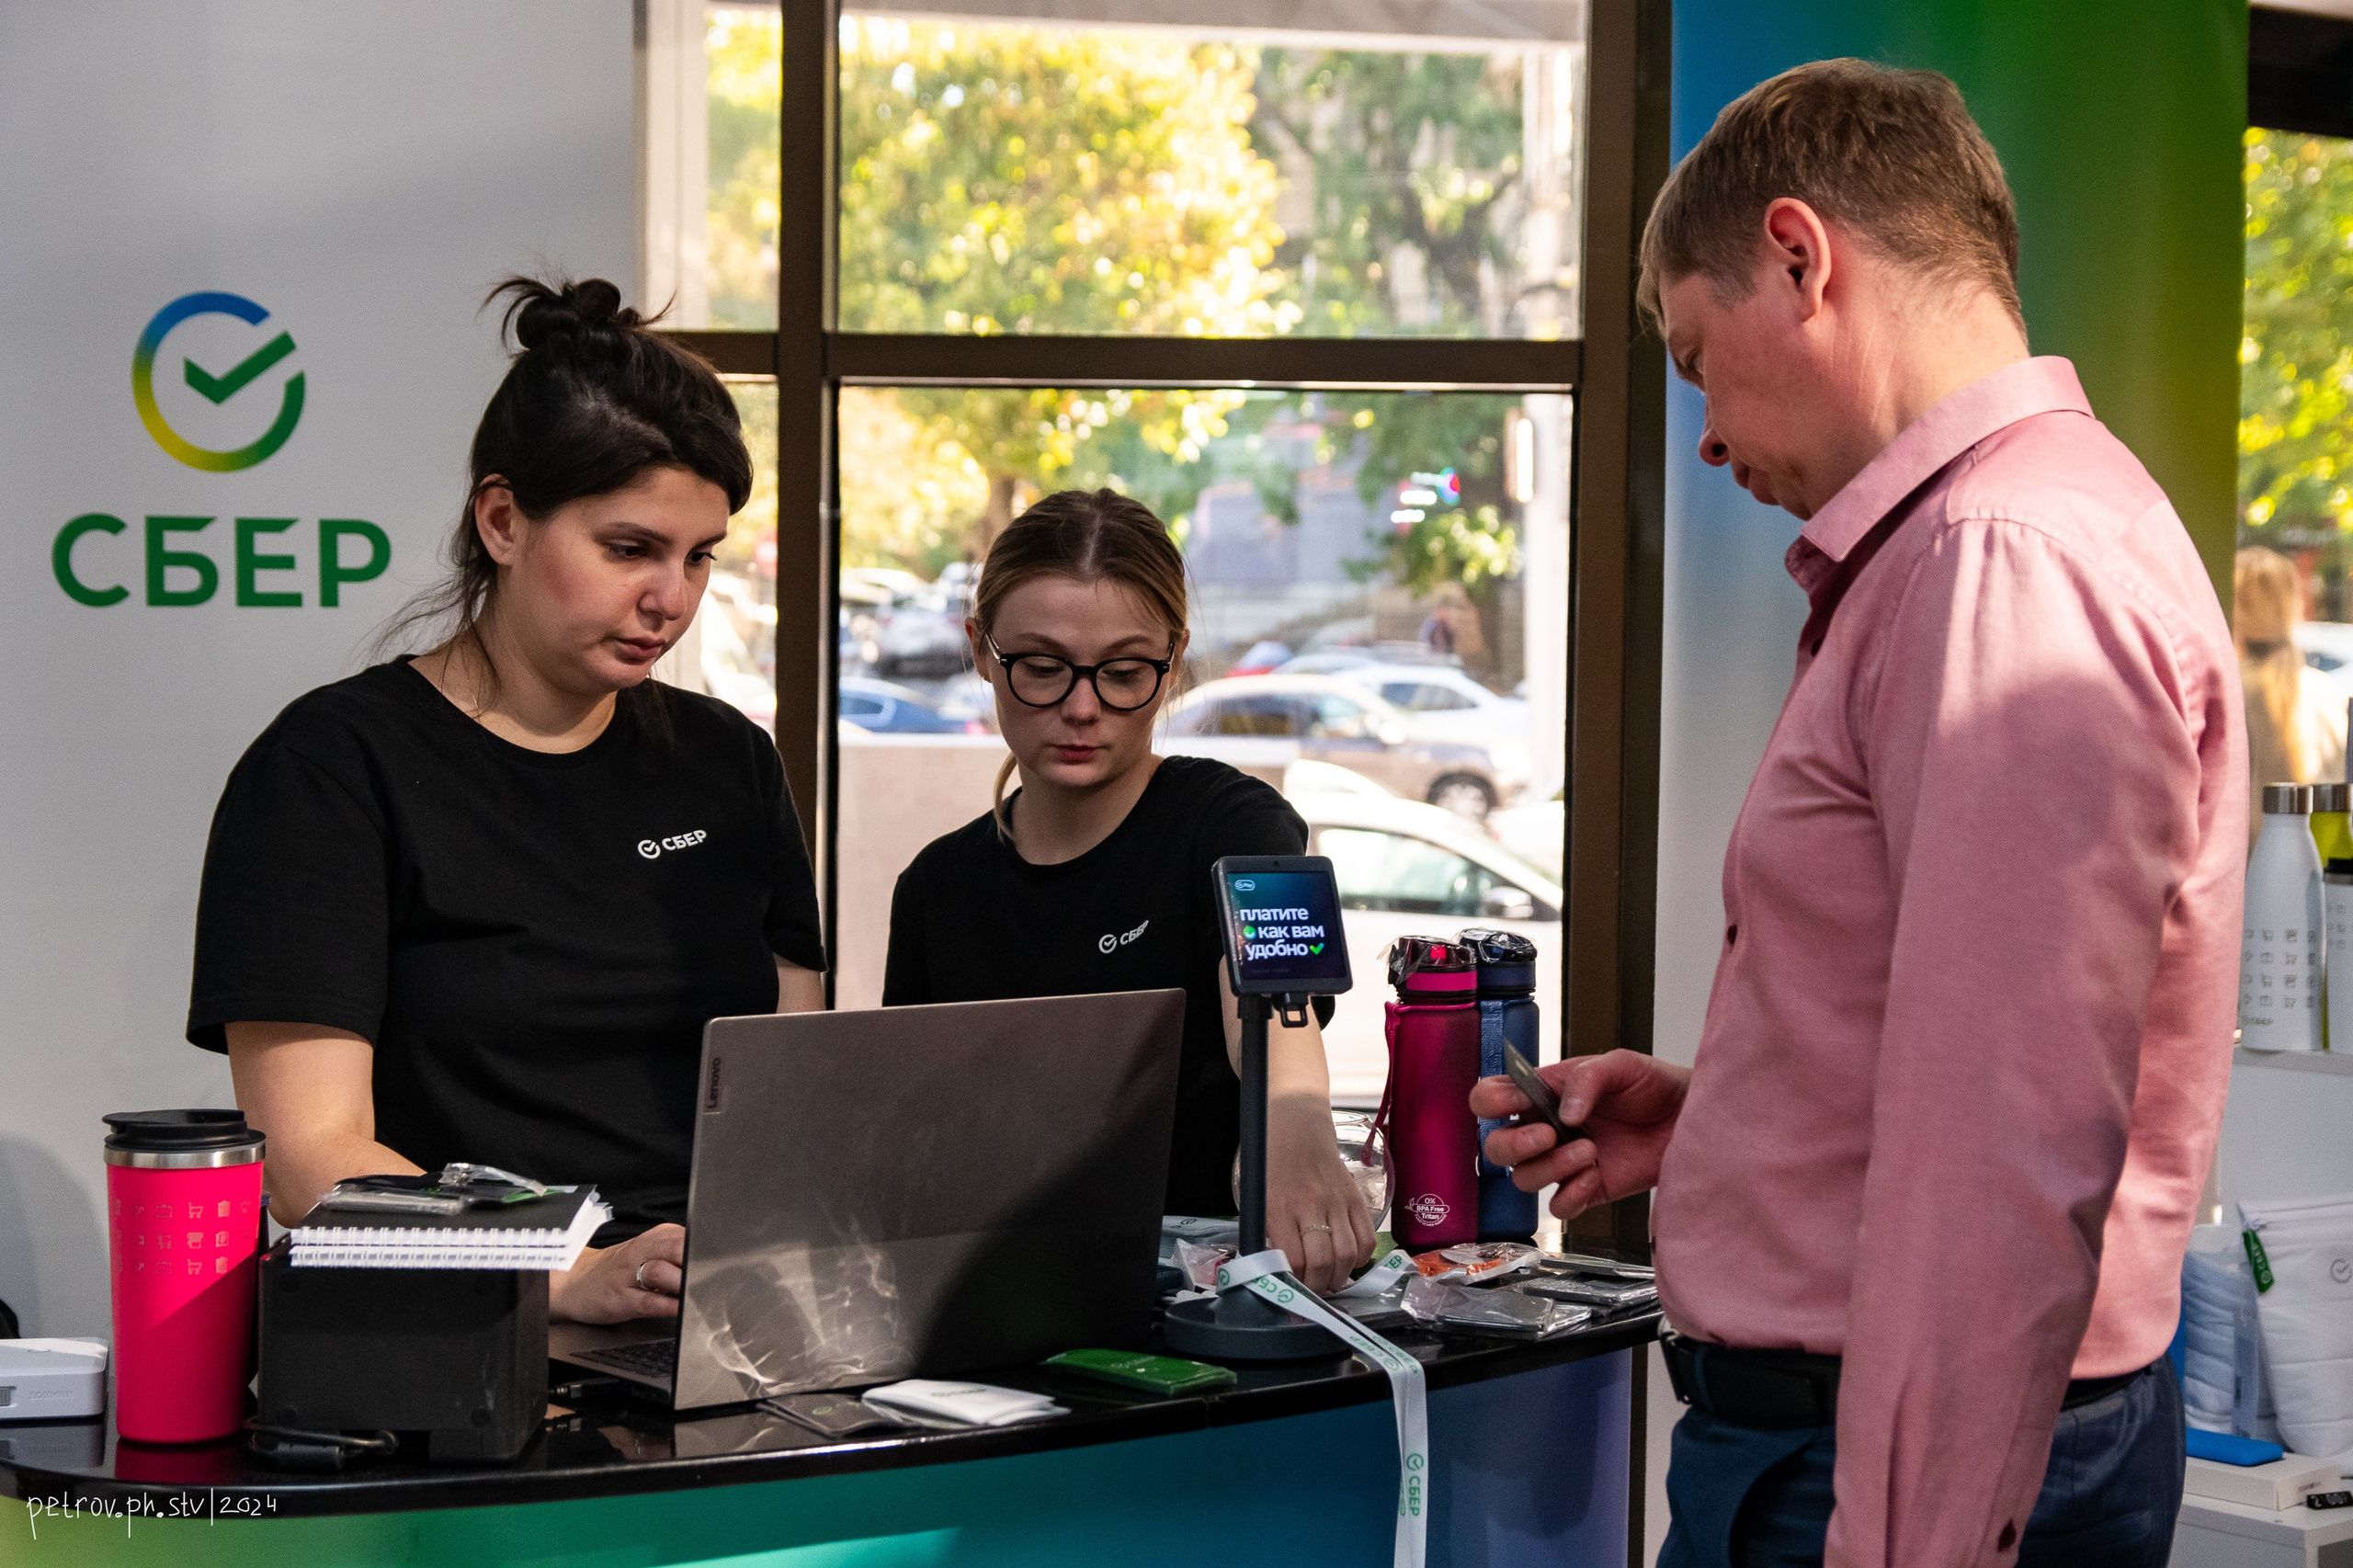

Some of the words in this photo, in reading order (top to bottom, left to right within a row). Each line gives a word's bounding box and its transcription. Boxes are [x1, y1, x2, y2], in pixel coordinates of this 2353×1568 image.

[52, 513, 392, 608] СБЕР
[662, 829, 707, 851] СБЕР
[1240, 908, 1309, 921] платите
[1120, 919, 1149, 946] СБЕР
[1257, 926, 1290, 939] как
[1292, 925, 1324, 938] вам
[1245, 938, 1309, 961] удобно
[707, 1057, 722, 1108] Lenovo
[1408, 1475, 1421, 1517] СБЕР
